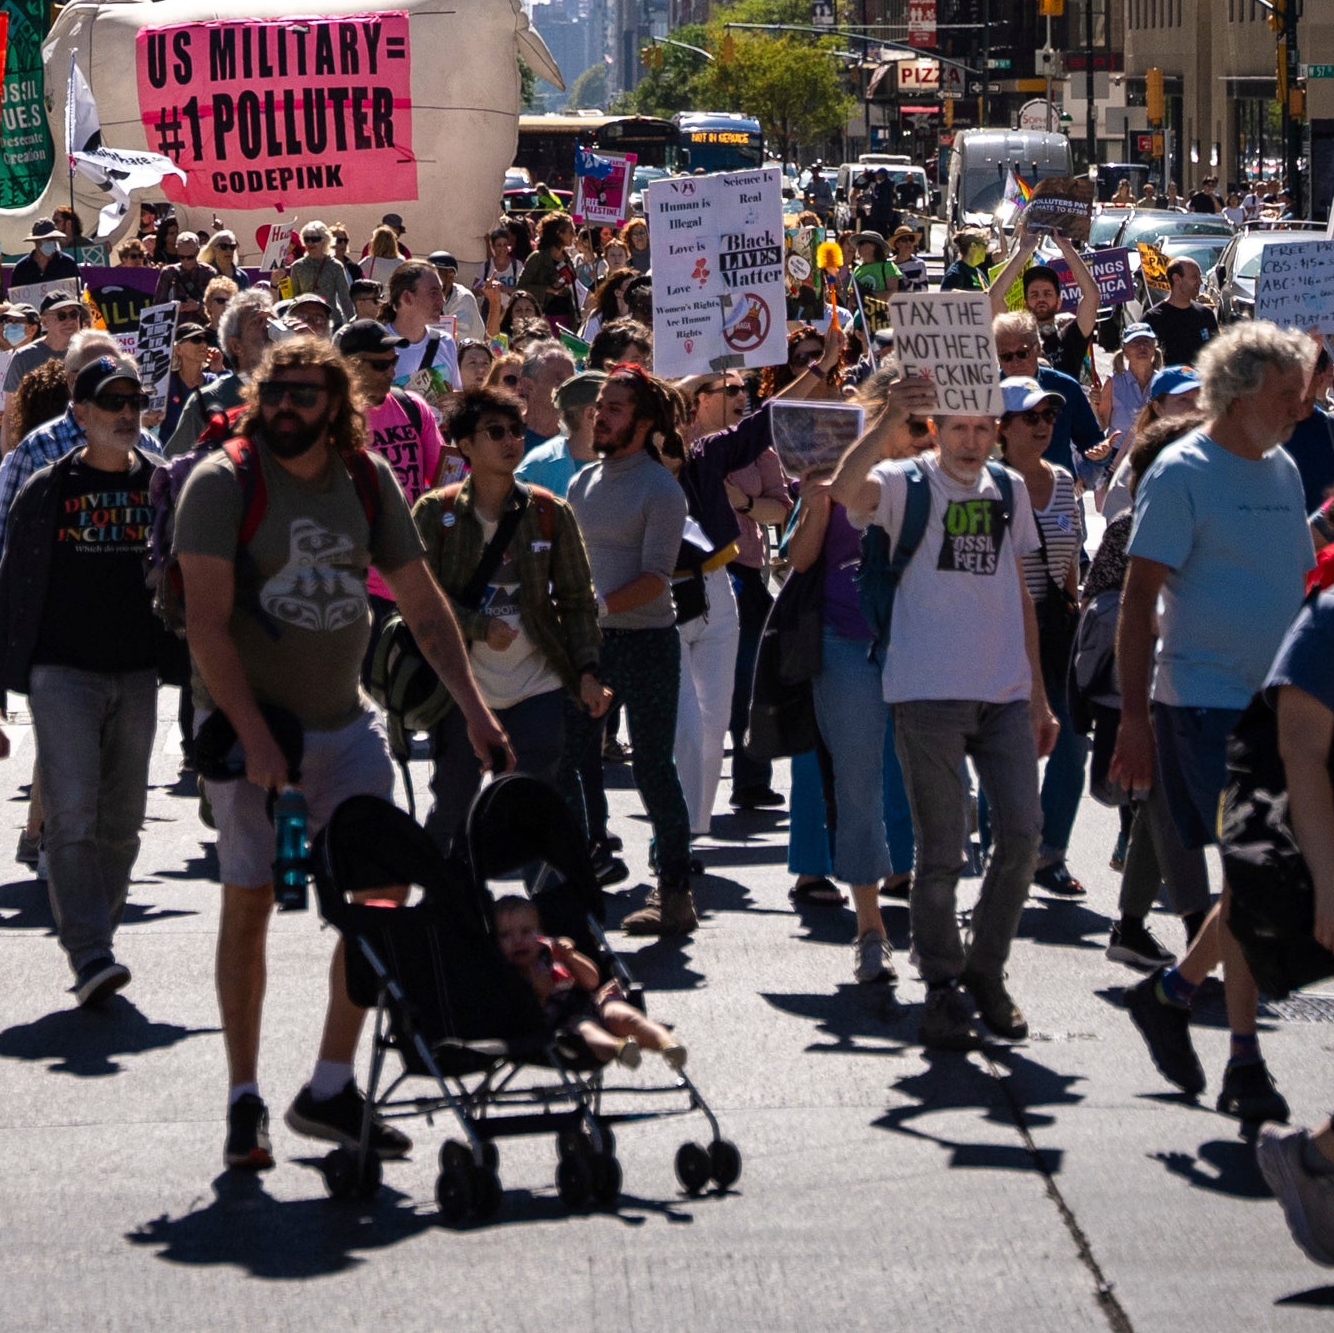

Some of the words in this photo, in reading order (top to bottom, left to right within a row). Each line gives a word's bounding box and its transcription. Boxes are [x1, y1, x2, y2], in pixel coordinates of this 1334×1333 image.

[147, 30, 193, 89] US
[901, 68, 961, 84] PIZZA
[1309, 66, 1315, 76] W
[1317, 65, 1325, 76] 57
[155, 95, 204, 164] #1
[212, 86, 396, 157] POLLUTER
[691, 132, 707, 143] NOT
[708, 132, 717, 143] IN
[718, 132, 750, 144] SERVICE
[211, 164, 344, 194] CODEPINK
[723, 174, 761, 187] Science
[763, 173, 773, 183] Is
[659, 201, 699, 213] Human
[702, 199, 711, 212] is
[739, 192, 762, 204] Real
[669, 217, 702, 231] Illegal
[669, 244, 695, 256] Love
[697, 241, 706, 253] is
[727, 231, 776, 252] Black
[721, 248, 779, 271] LIVES
[1270, 246, 1306, 257] FREE
[721, 268, 783, 288] Matter
[667, 285, 691, 297] Love
[655, 305, 691, 316] Women's
[694, 300, 720, 312] Rights
[894, 300, 941, 327] TAX
[943, 300, 983, 326] THE
[681, 315, 711, 326] Human
[676, 328, 702, 340] Rights
[896, 334, 991, 361] MOTHER
[372, 425, 417, 448] AKE
[79, 507, 155, 528] EQUITY
[947, 500, 992, 535] OFF
